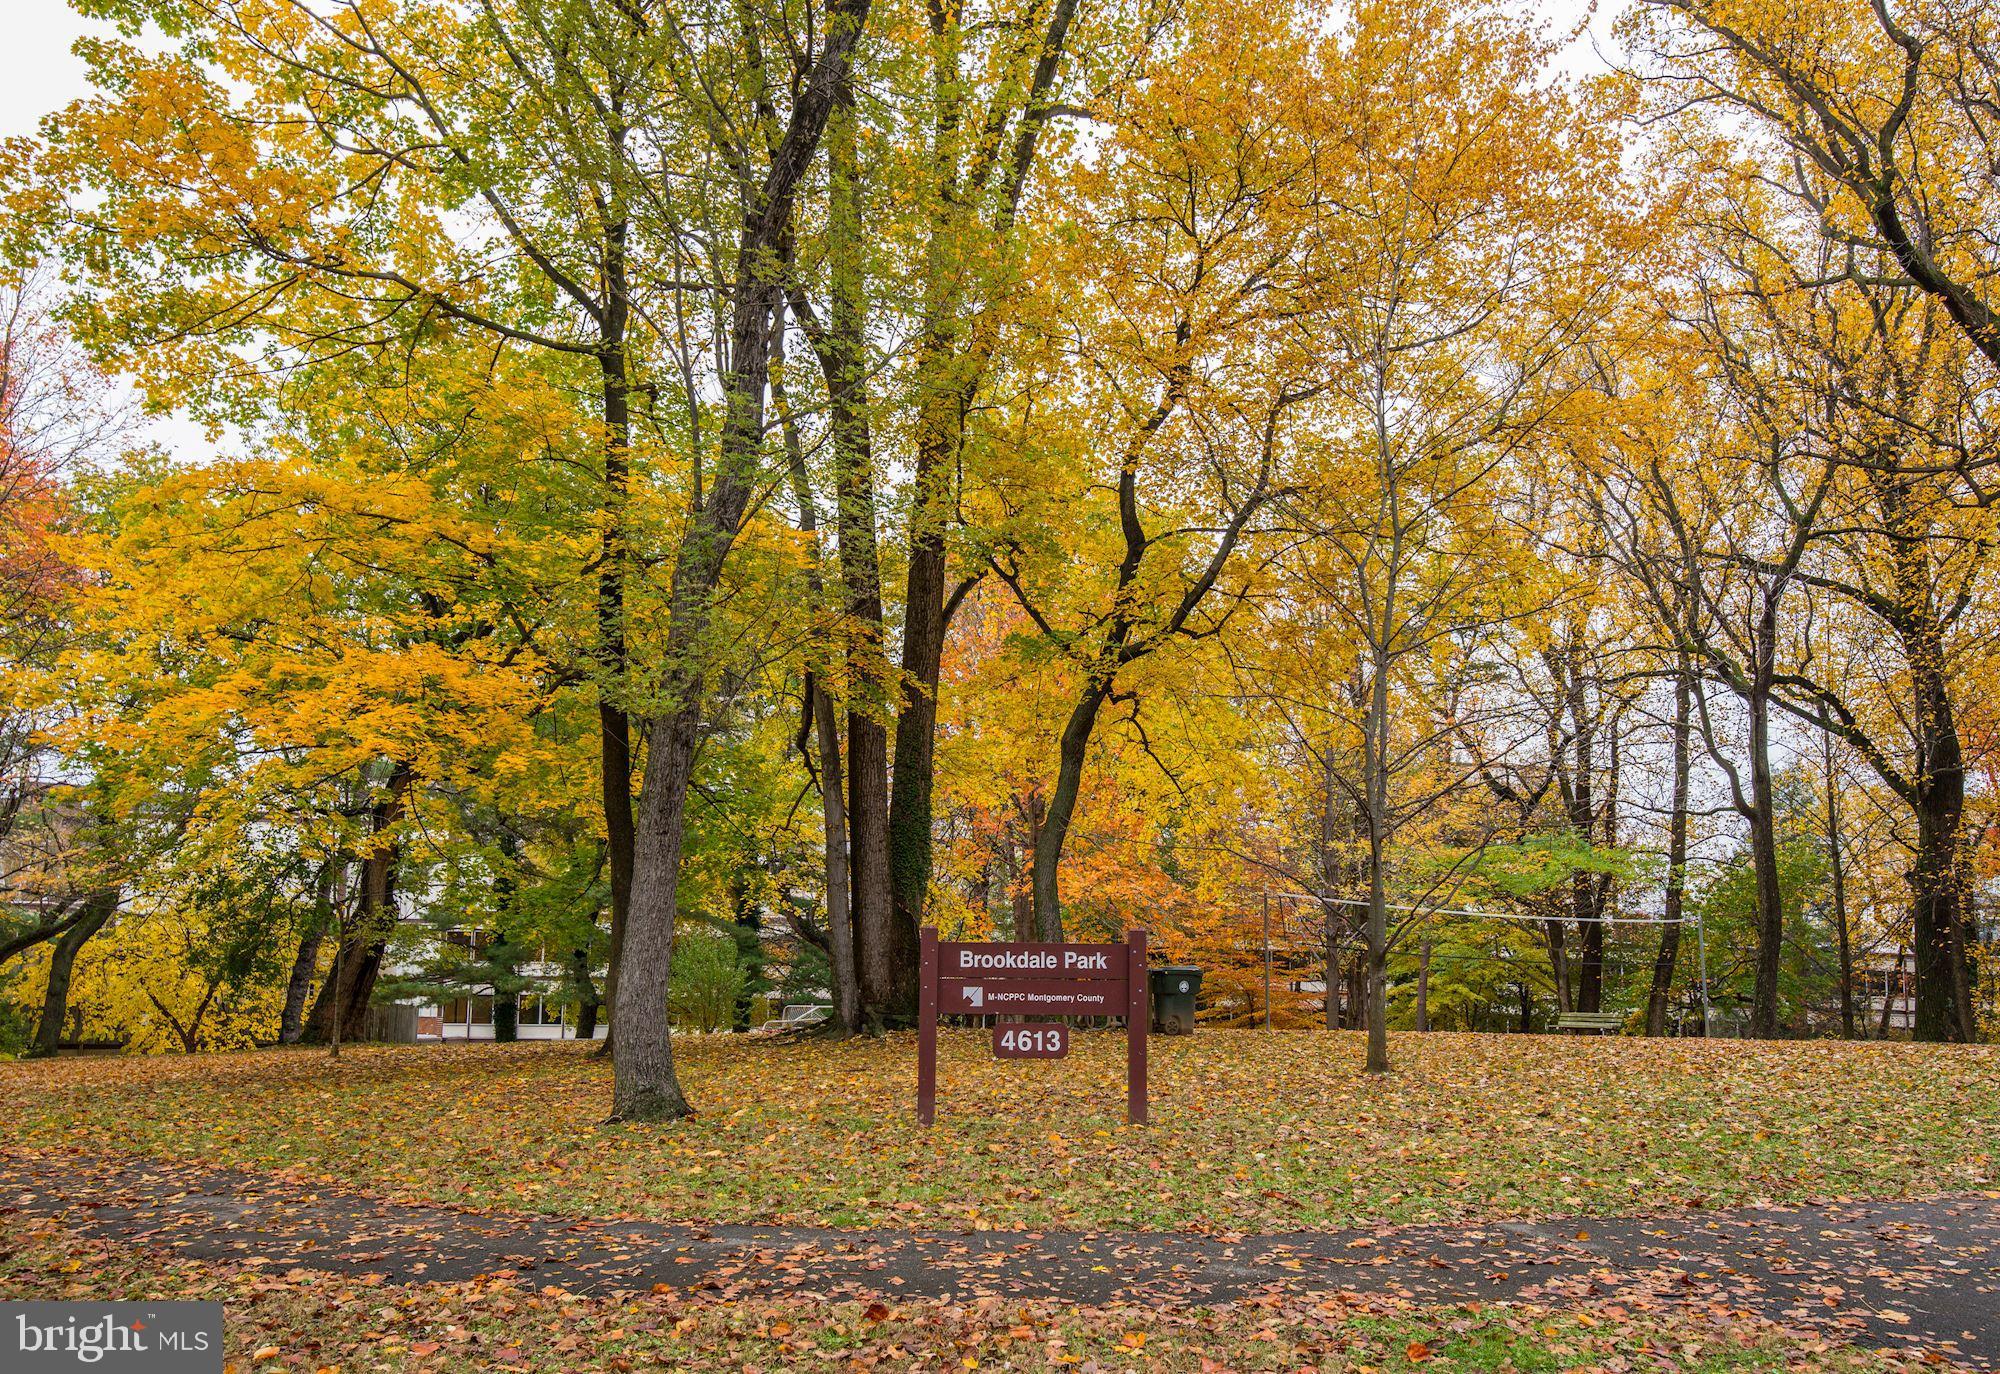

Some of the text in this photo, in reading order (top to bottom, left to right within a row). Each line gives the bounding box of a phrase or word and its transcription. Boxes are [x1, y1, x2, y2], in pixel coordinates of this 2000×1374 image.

[960, 950, 1108, 970] Brookdale Park
[987, 992, 1105, 1004] M-NCPPC Montgomery County
[1000, 1029, 1061, 1052] 4613
